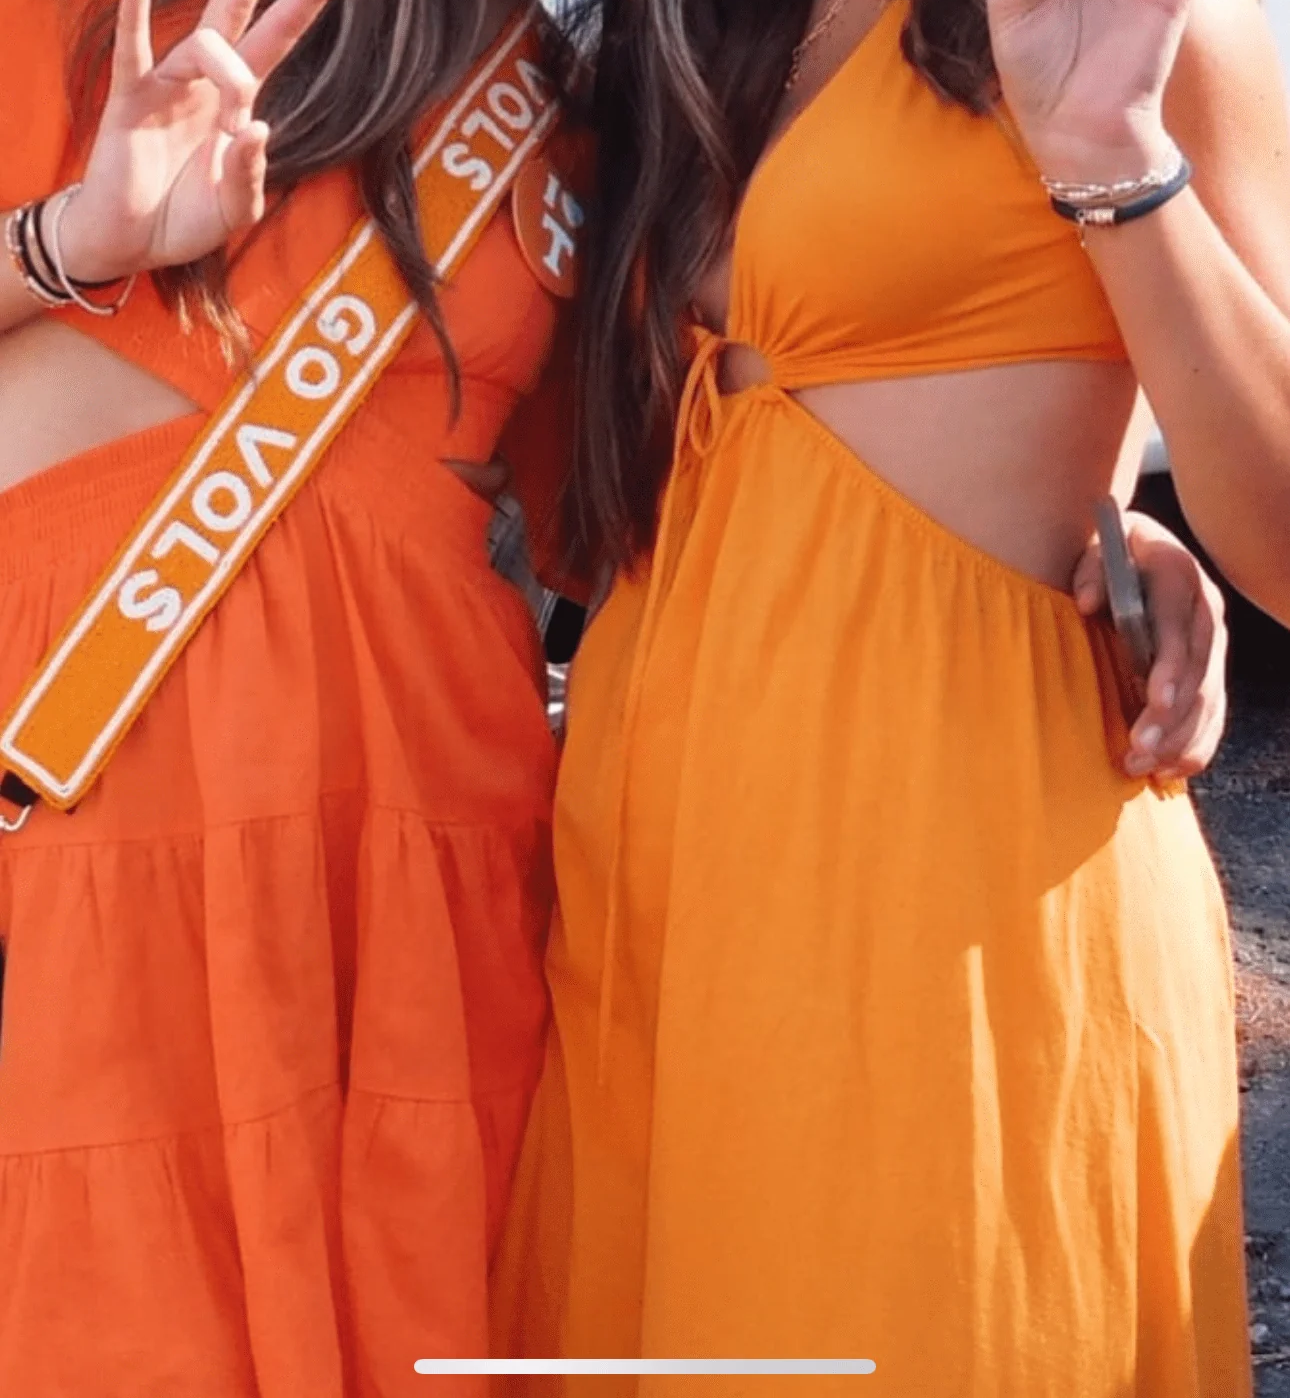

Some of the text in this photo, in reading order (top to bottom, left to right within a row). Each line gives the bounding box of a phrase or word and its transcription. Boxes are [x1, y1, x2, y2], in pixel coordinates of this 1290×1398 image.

[440, 57, 547, 191] VOLS
[117, 293, 378, 633] GO VOLS
